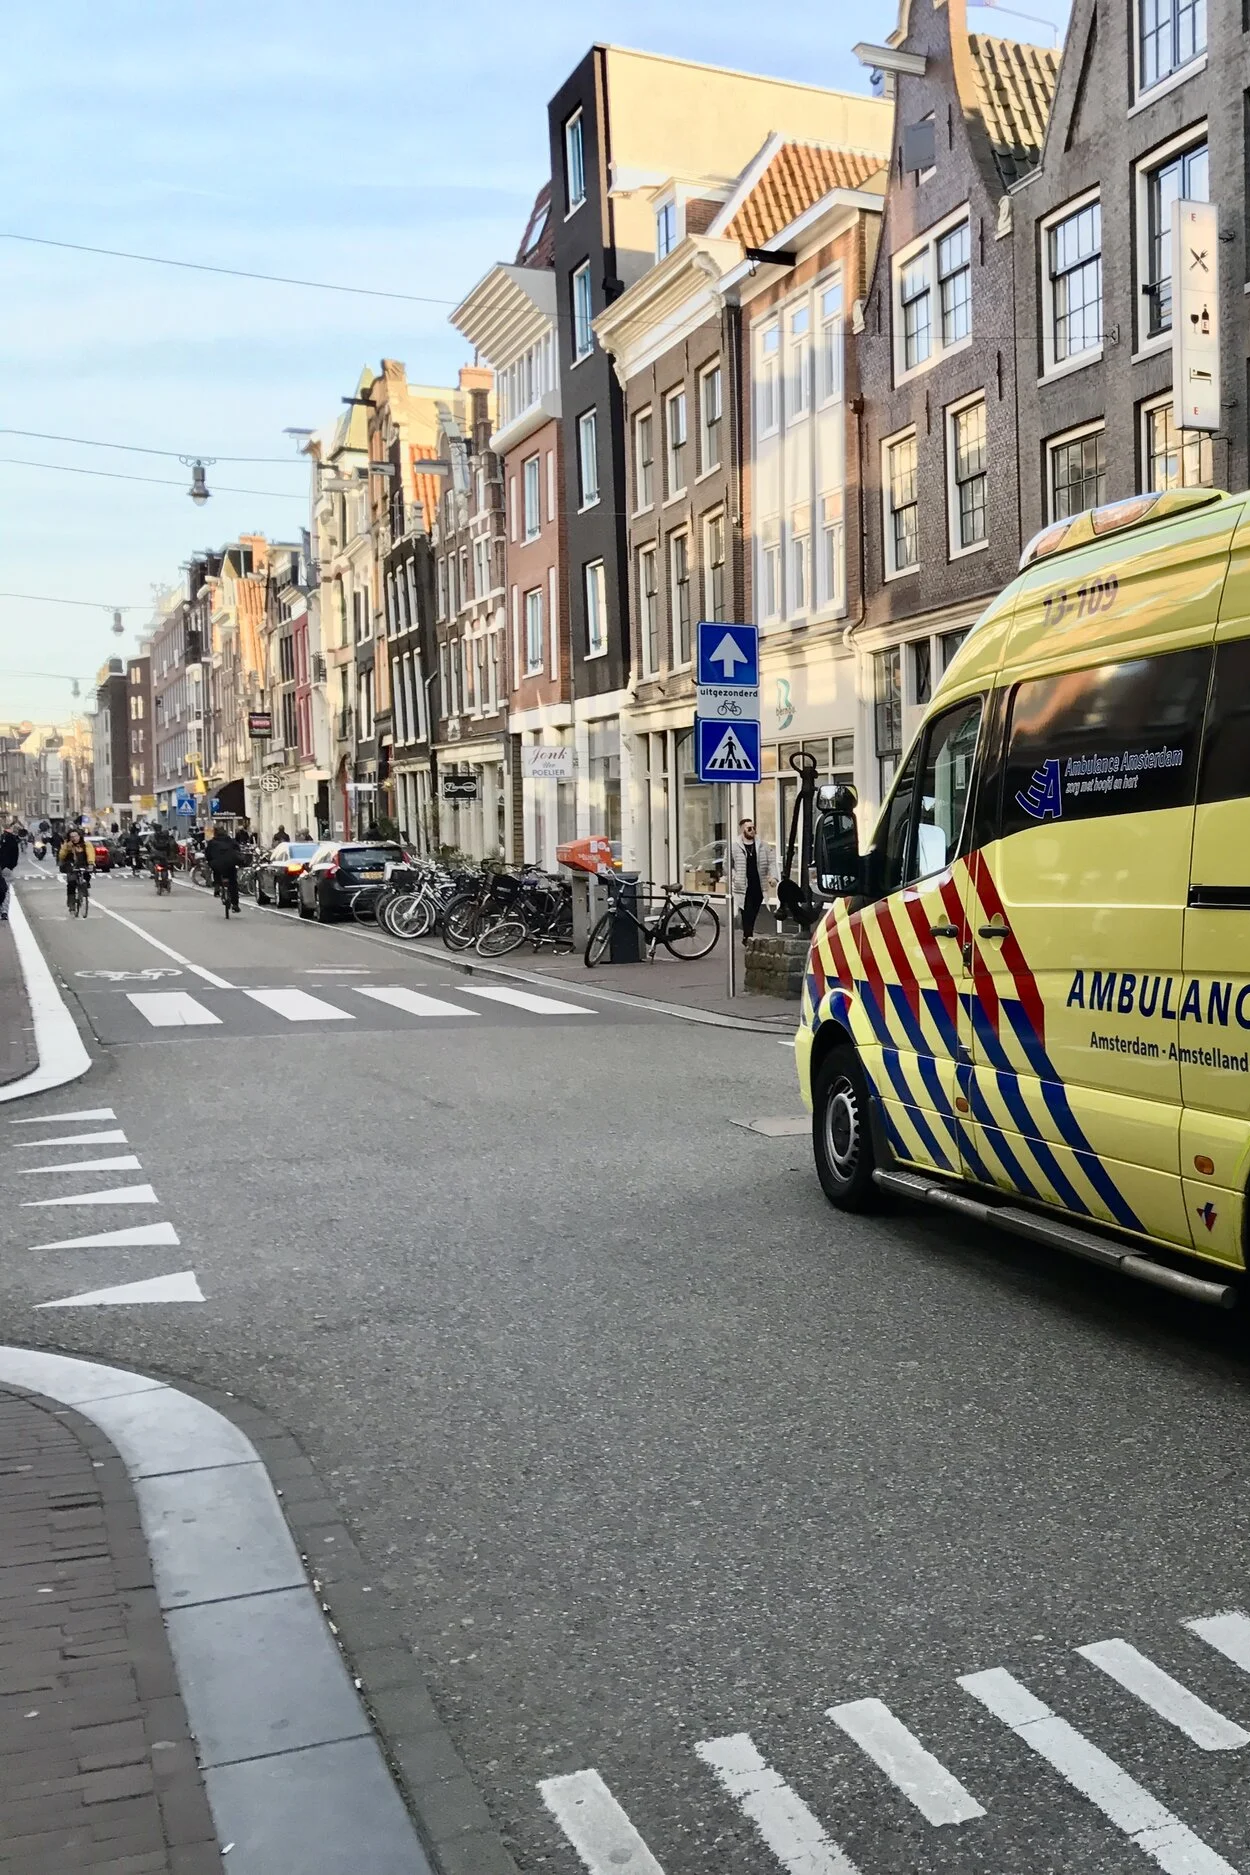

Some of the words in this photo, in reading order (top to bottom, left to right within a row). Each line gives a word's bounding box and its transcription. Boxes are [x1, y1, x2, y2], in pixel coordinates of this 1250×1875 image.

[1042, 573, 1119, 627] 13-109
[700, 688, 758, 698] uitgezonderd
[1064, 753, 1120, 777] Ambulance
[1120, 745, 1184, 772] Amsterdam
[1065, 781, 1080, 796] zorg
[1080, 778, 1094, 793] met
[1113, 779, 1122, 790] en
[1122, 774, 1139, 789] hart
[1090, 1030, 1160, 1058] Amsterdam
[1168, 1046, 1250, 1073] Amstelland
